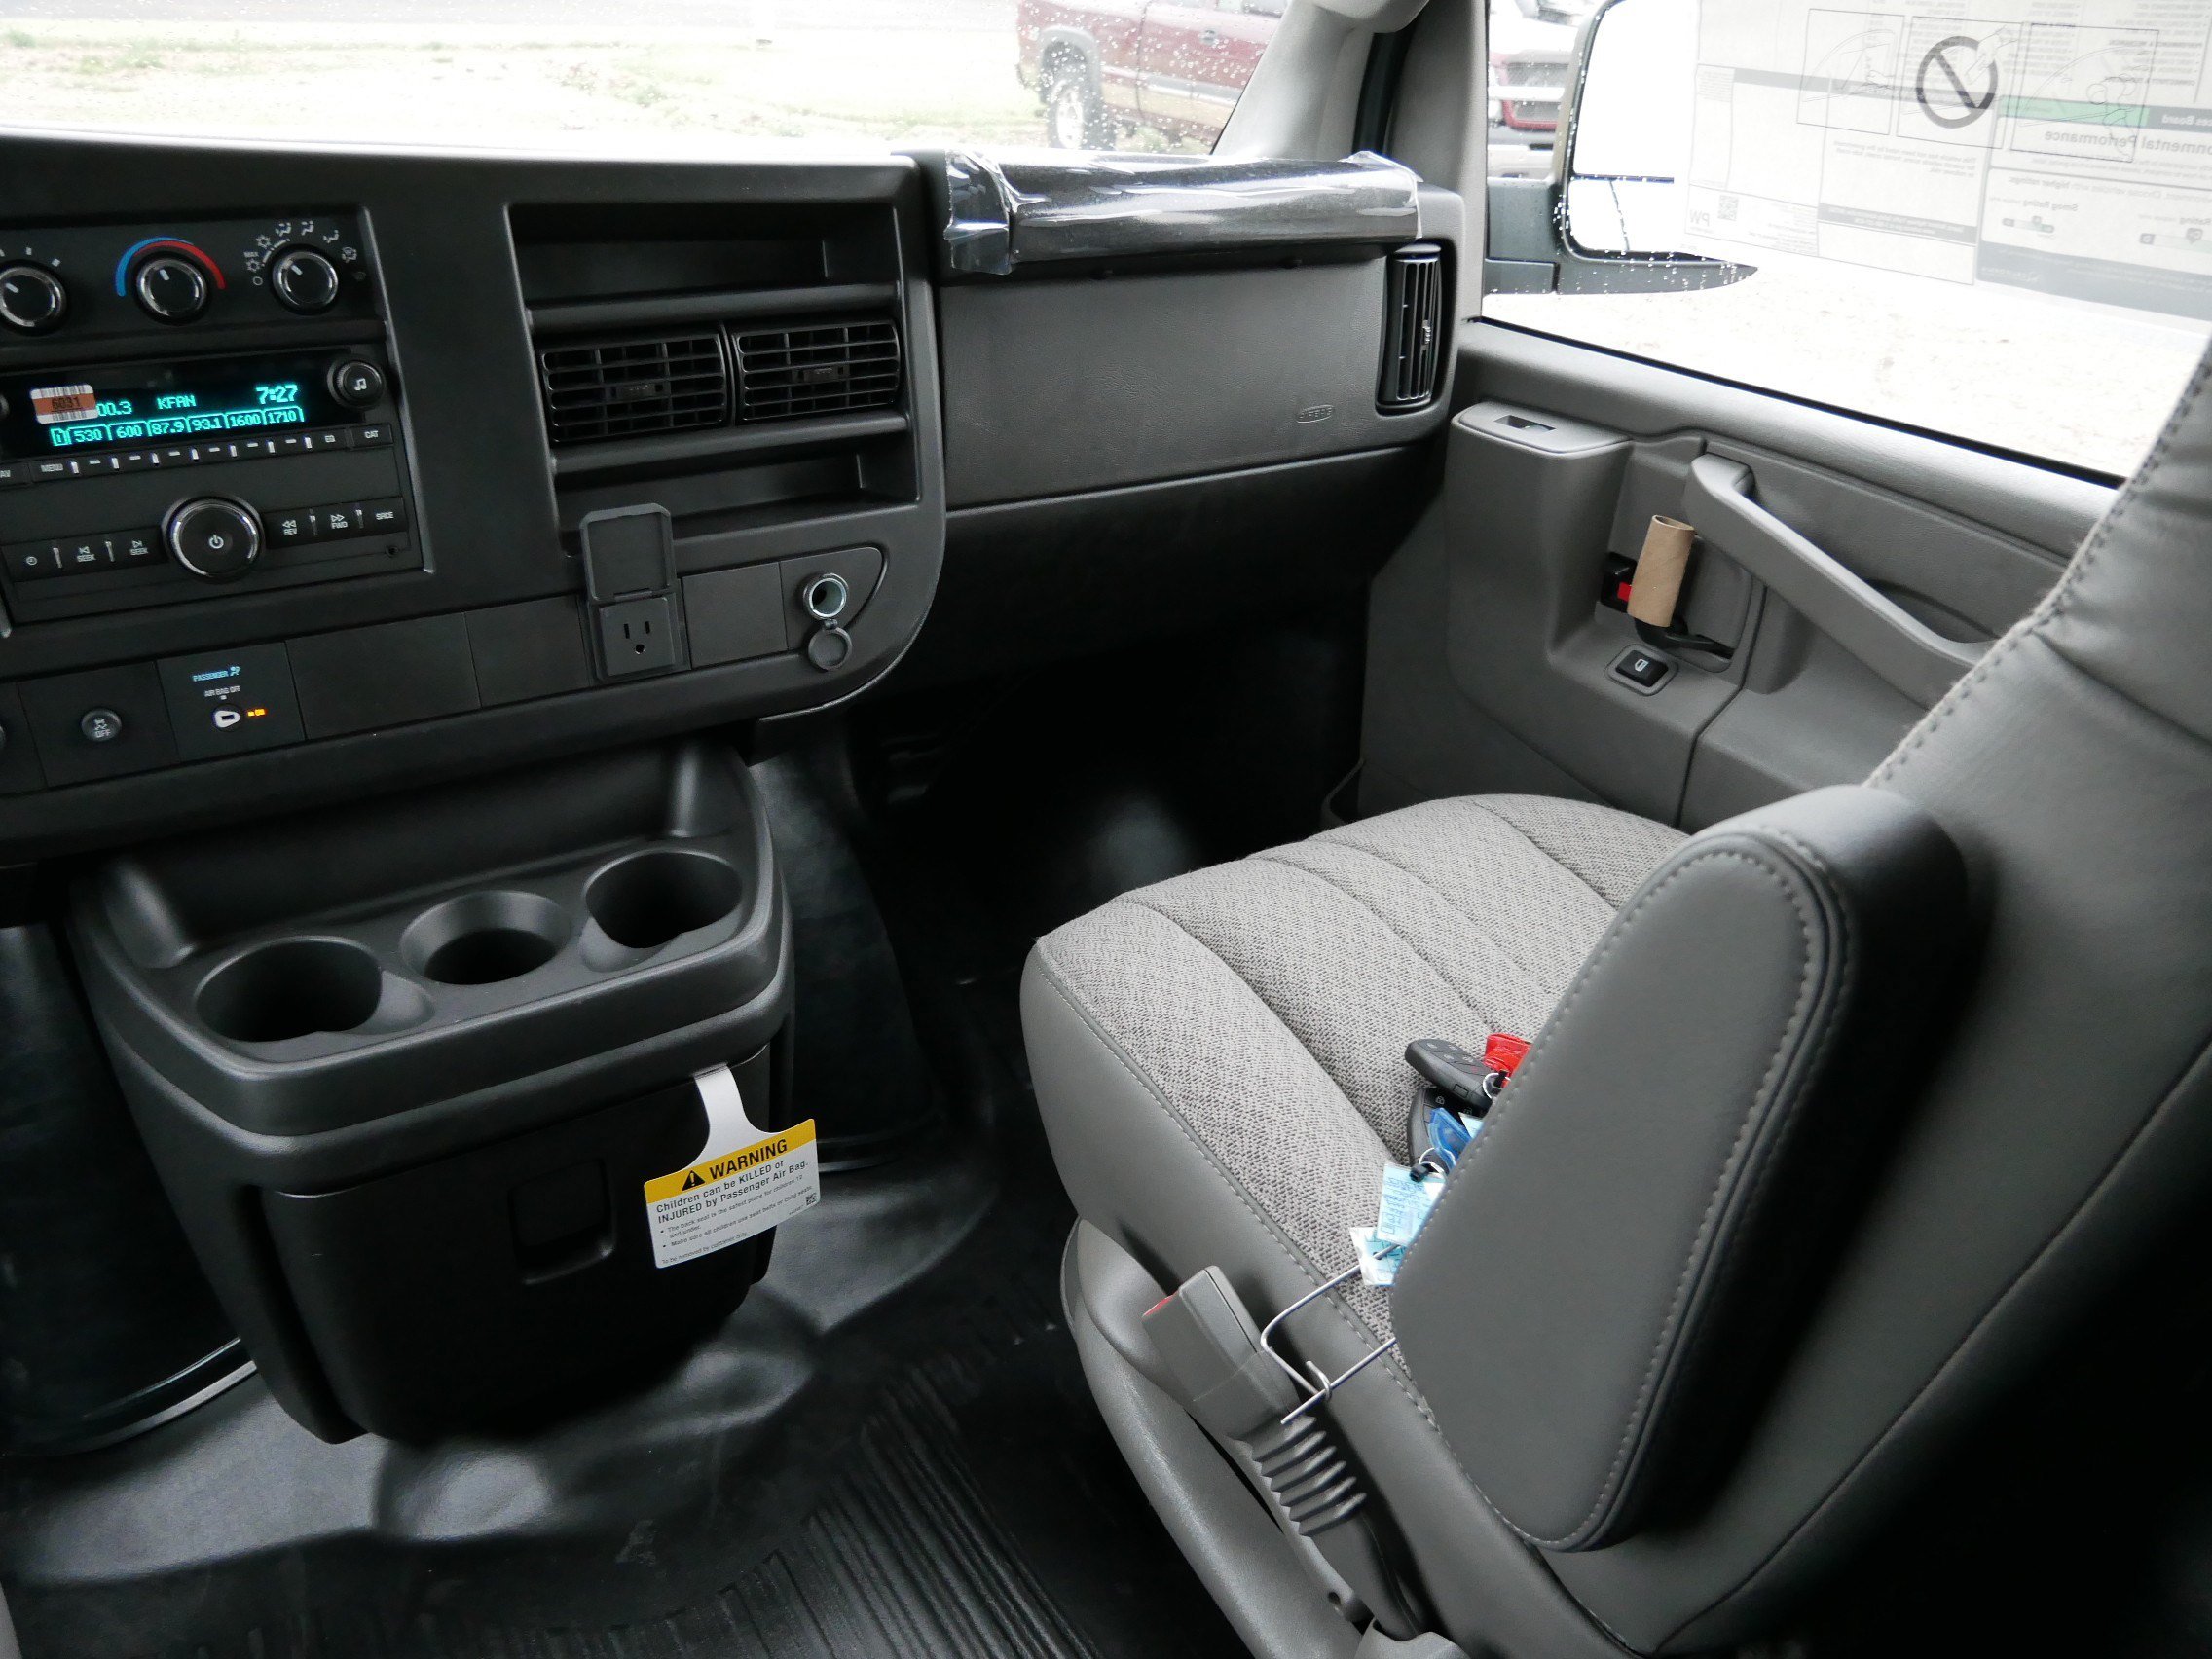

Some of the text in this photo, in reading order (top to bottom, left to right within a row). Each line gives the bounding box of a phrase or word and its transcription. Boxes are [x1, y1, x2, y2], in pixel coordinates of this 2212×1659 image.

[157, 393, 197, 411] KFAN
[256, 384, 299, 406] 7:27
[73, 426, 103, 443] 530
[116, 424, 143, 440] 600
[151, 419, 185, 436] 87.9
[230, 412, 262, 428] 1600
[268, 409, 298, 424] 1710
[364, 429, 379, 439] CAT
[331, 521, 349, 530] FWD
[708, 1138, 789, 1182] WARNING
[655, 1159, 785, 1214] Children can be KILLED or
[658, 1161, 810, 1225] INJURED by Passenger Air Bag.
